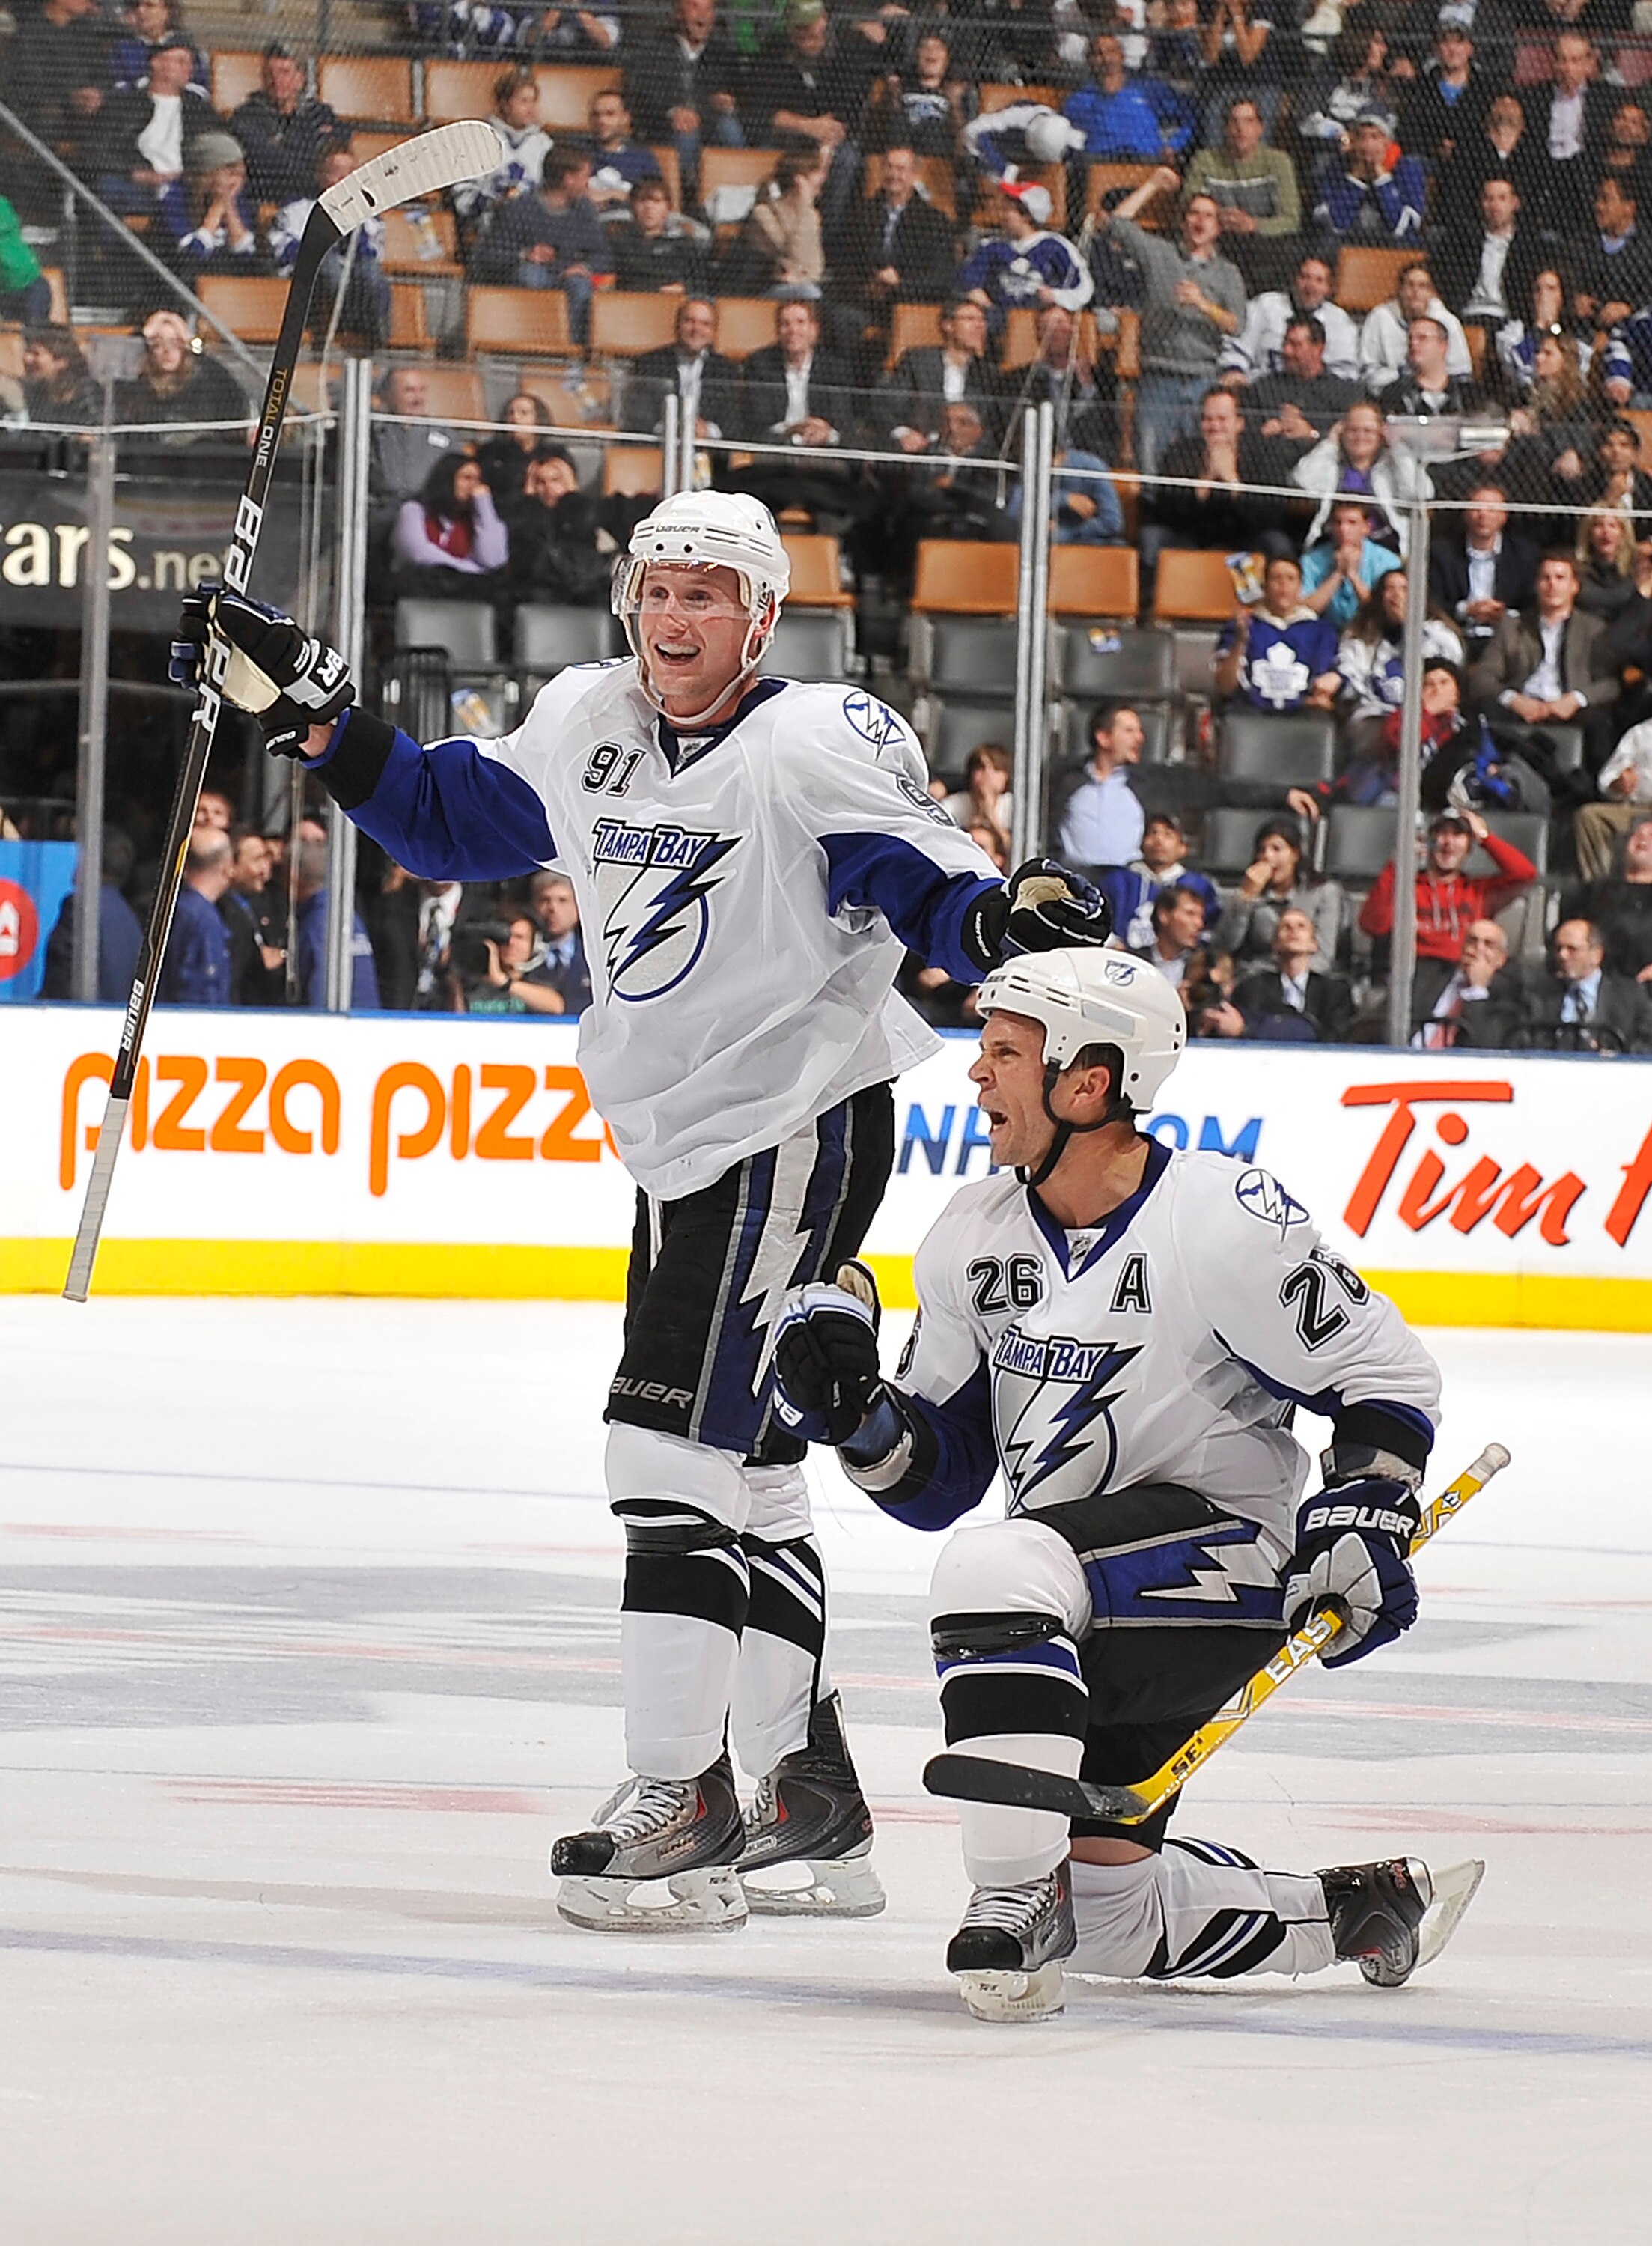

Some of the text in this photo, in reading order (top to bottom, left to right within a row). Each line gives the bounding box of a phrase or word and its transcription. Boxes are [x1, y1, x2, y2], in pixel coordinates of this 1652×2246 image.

[256, 368, 288, 468] TOTAL ONE
[582, 742, 646, 797] 91
[596, 823, 707, 866] TAMPA BAY
[121, 978, 145, 1052] BAUER
[369, 1062, 624, 1197] pizz
[1340, 1080, 1587, 1247] Tim
[966, 1253, 1043, 1315] 26
[1109, 1253, 1153, 1314] A
[1278, 1250, 1371, 1353] 26
[997, 1328, 1104, 1379] TAMPA BAY
[1304, 1505, 1416, 1538] BAUER
